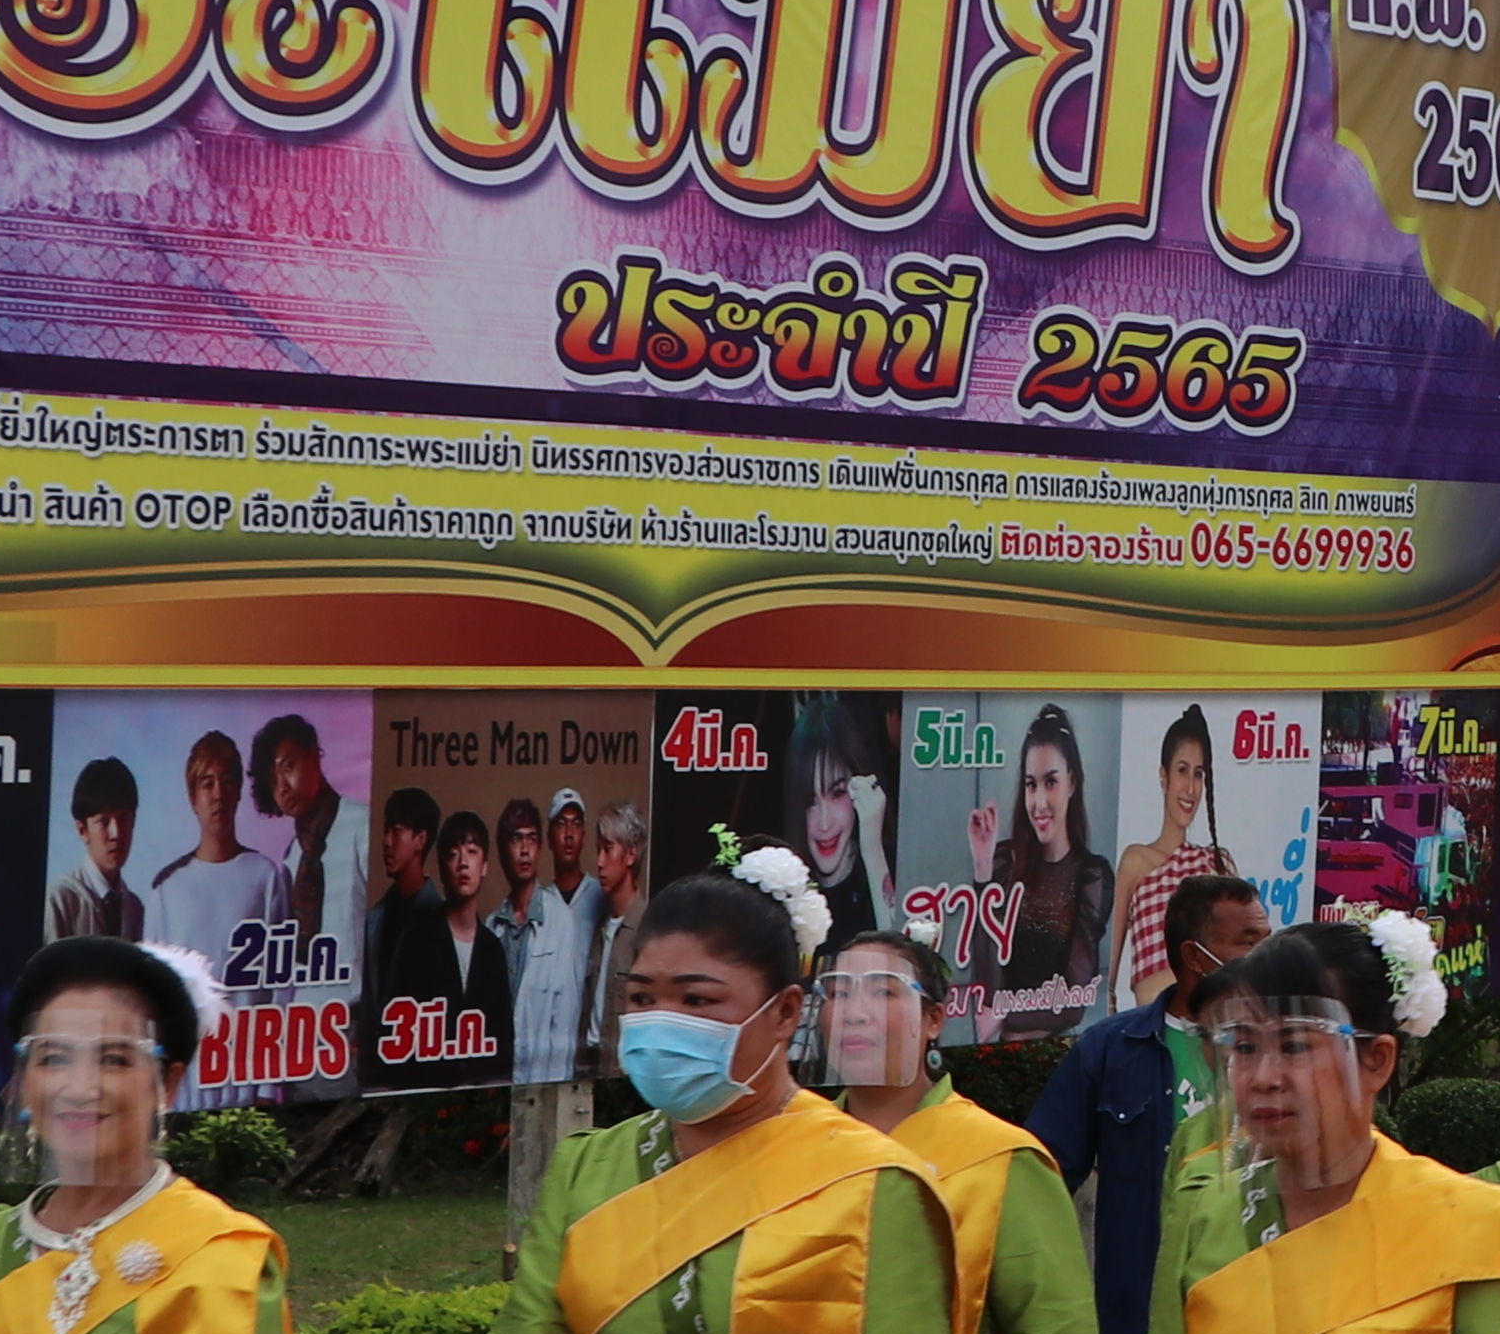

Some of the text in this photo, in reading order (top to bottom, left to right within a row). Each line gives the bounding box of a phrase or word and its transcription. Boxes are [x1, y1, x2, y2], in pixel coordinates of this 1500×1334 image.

[552, 248, 1305, 435] ประจำปี 2565
[255, 423, 522, 471] ร่วมสักการะพระแม่ย่า
[1299, 483, 1329, 512] ลิเก
[1333, 483, 1418, 518] ภาพยนตร์
[44, 482, 123, 528] สินค้า
[135, 491, 231, 532] OTOP
[242, 483, 514, 549] เลือกซื้อสินค้าราคาถูก
[523, 506, 632, 544] จากบริษัท
[640, 509, 827, 554] ห้างร้านและโรงงาน
[834, 521, 994, 563] สวนสนุกชุดใหญ่
[1000, 520, 1185, 565] ติดต่อจองร้าน
[1190, 521, 1416, 573] 065-6699936
[389, 717, 640, 768] Three Man Down
